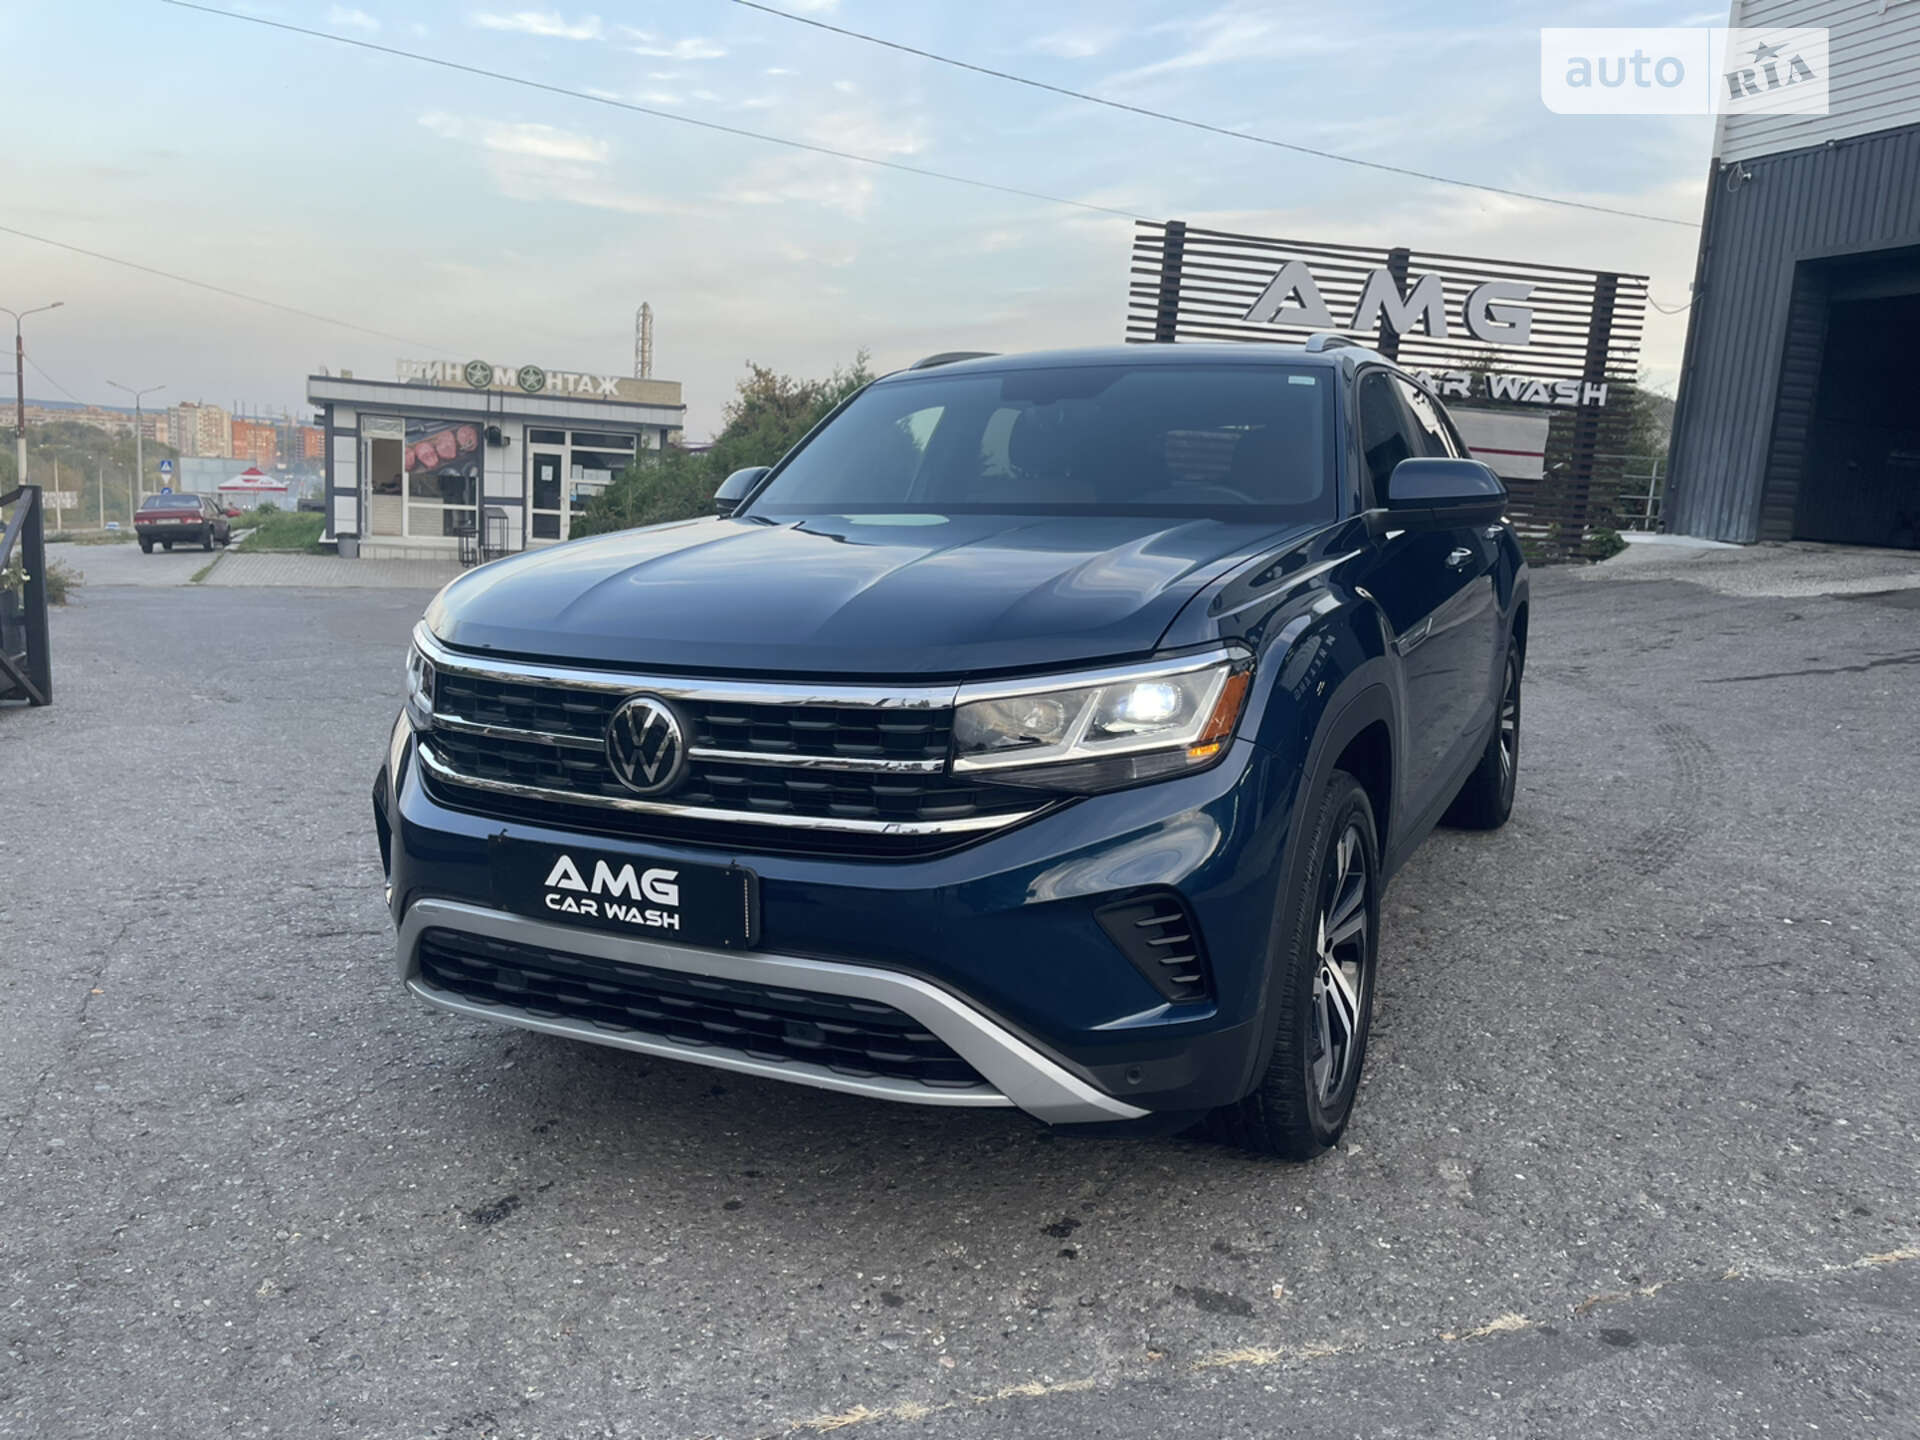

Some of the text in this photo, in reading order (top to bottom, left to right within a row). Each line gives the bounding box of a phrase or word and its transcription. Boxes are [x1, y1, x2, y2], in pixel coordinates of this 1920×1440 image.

[1242, 260, 1537, 346] AMG
[1411, 370, 1609, 407] AR WASH
[544, 854, 680, 907] AMG
[544, 893, 680, 931] CAR WASH
